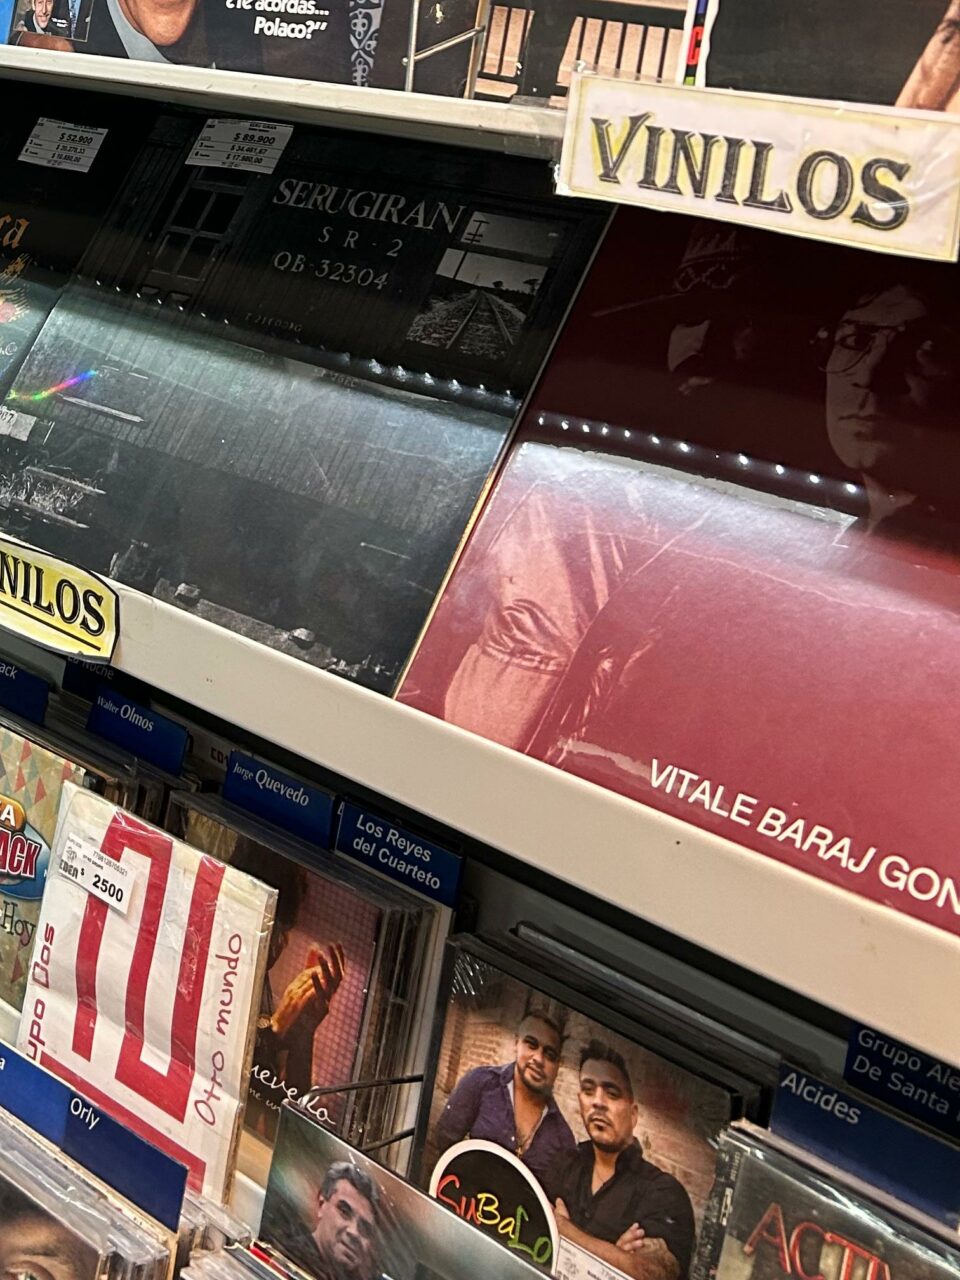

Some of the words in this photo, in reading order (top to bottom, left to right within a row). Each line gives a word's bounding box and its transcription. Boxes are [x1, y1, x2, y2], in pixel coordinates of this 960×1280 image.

[67, 134, 93, 144] 52.900
[243, 133, 276, 144] 89.900
[589, 111, 912, 232] VINILOS
[273, 178, 467, 234] SERUGIRAN
[97, 695, 120, 715] Walter
[119, 703, 155, 733] Olmos
[232, 761, 255, 782] Jorge
[255, 769, 310, 807] Quevedo
[356, 813, 385, 839] Los
[385, 827, 432, 864] Reyes
[650, 758, 755, 829] VITALE
[755, 804, 879, 880] BARAJ
[93, 873, 124, 903] 2500
[352, 837, 378, 862] del
[377, 846, 441, 890] Cuarteto
[1, 900, 36, 947] Hoy
[32, 922, 55, 990] Dos
[194, 1050, 225, 1127] Otro
[215, 933, 242, 1037] mundo
[857, 1027, 922, 1073] Grupo
[780, 1071, 862, 1125] Alcides
[852, 1054, 884, 1081] De
[884, 1071, 949, 1116] Santa
[69, 1095, 101, 1131] Orly
